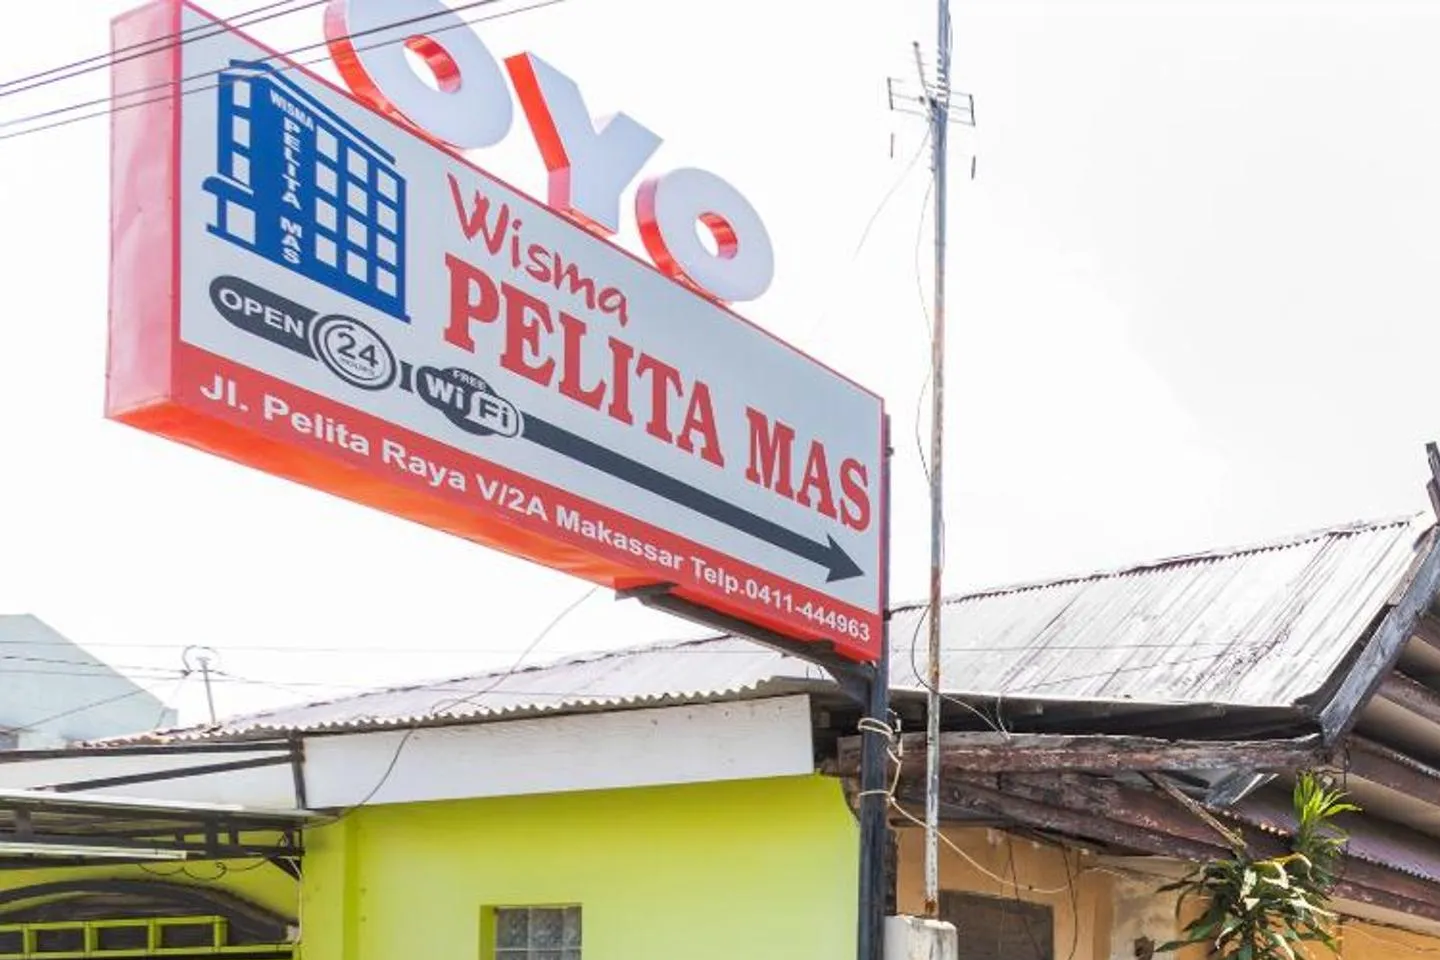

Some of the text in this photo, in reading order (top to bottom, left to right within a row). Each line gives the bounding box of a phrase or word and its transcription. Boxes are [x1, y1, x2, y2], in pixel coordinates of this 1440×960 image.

[270, 88, 314, 131] WISMA
[323, 0, 775, 302] OYO
[280, 117, 303, 264] PELITA MAS
[447, 172, 628, 327] Wisma
[219, 288, 379, 368] OPEN 24
[443, 252, 872, 532] PELITA MAS
[199, 372, 249, 412] Jl.
[263, 394, 370, 456] Pelita
[382, 438, 467, 492] Raya
[476, 473, 549, 522] V/2A
[556, 505, 684, 571] Makassar
